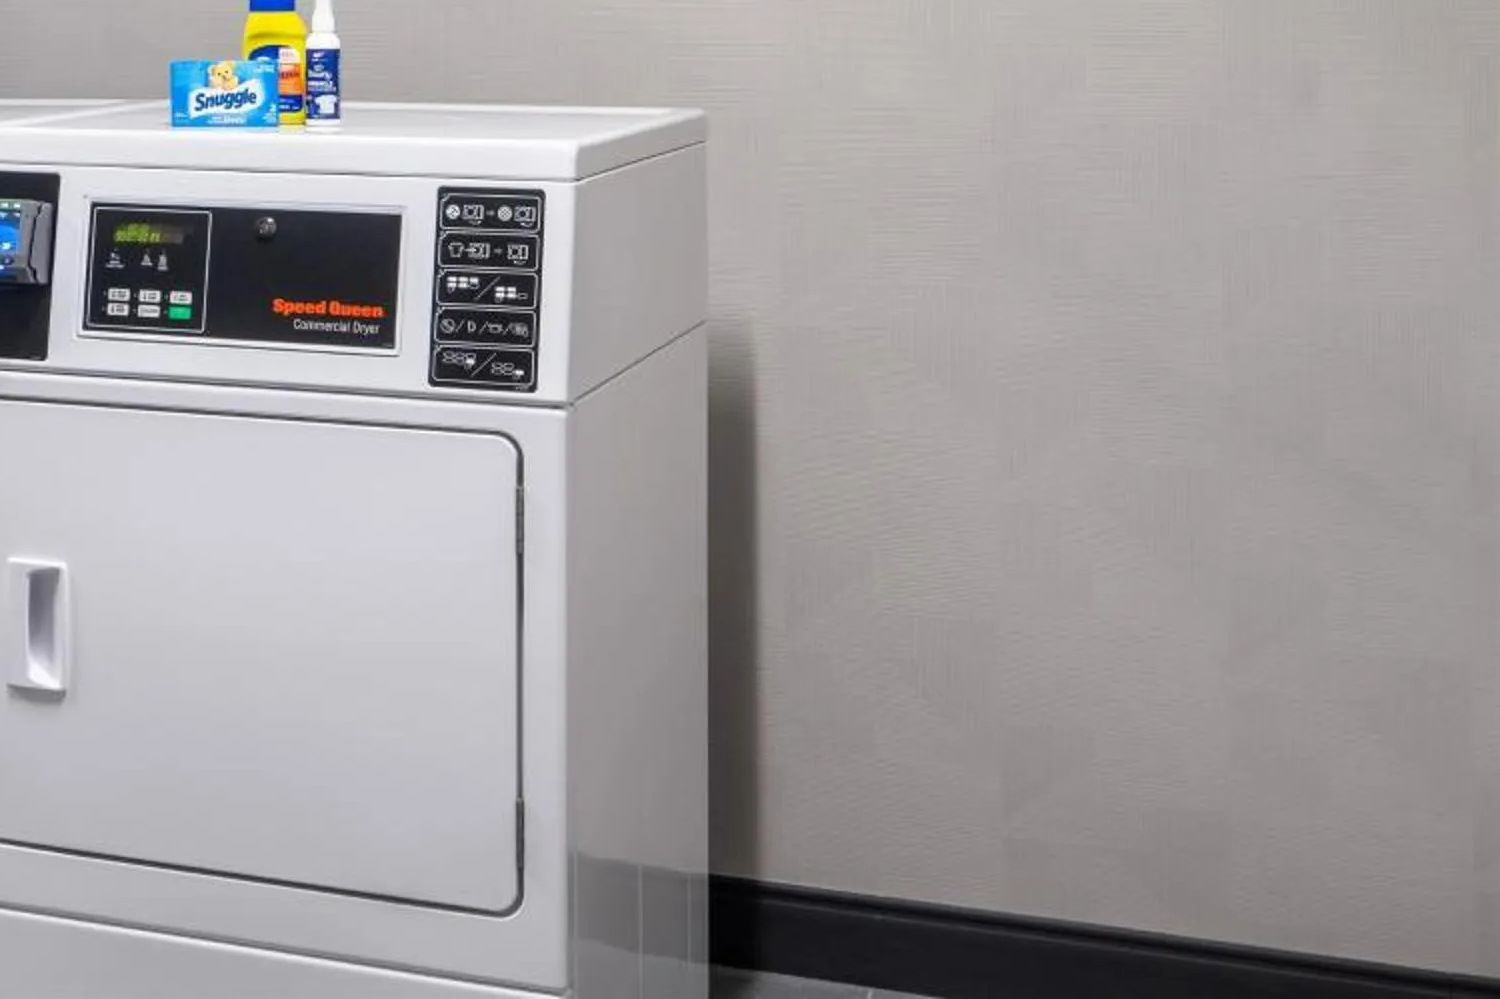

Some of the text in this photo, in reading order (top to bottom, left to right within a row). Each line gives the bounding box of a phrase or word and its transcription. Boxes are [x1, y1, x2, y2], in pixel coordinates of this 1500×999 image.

[194, 88, 257, 112] Snuggle
[273, 298, 385, 318] Speed Queen
[293, 318, 380, 336] Commercial Dryer
